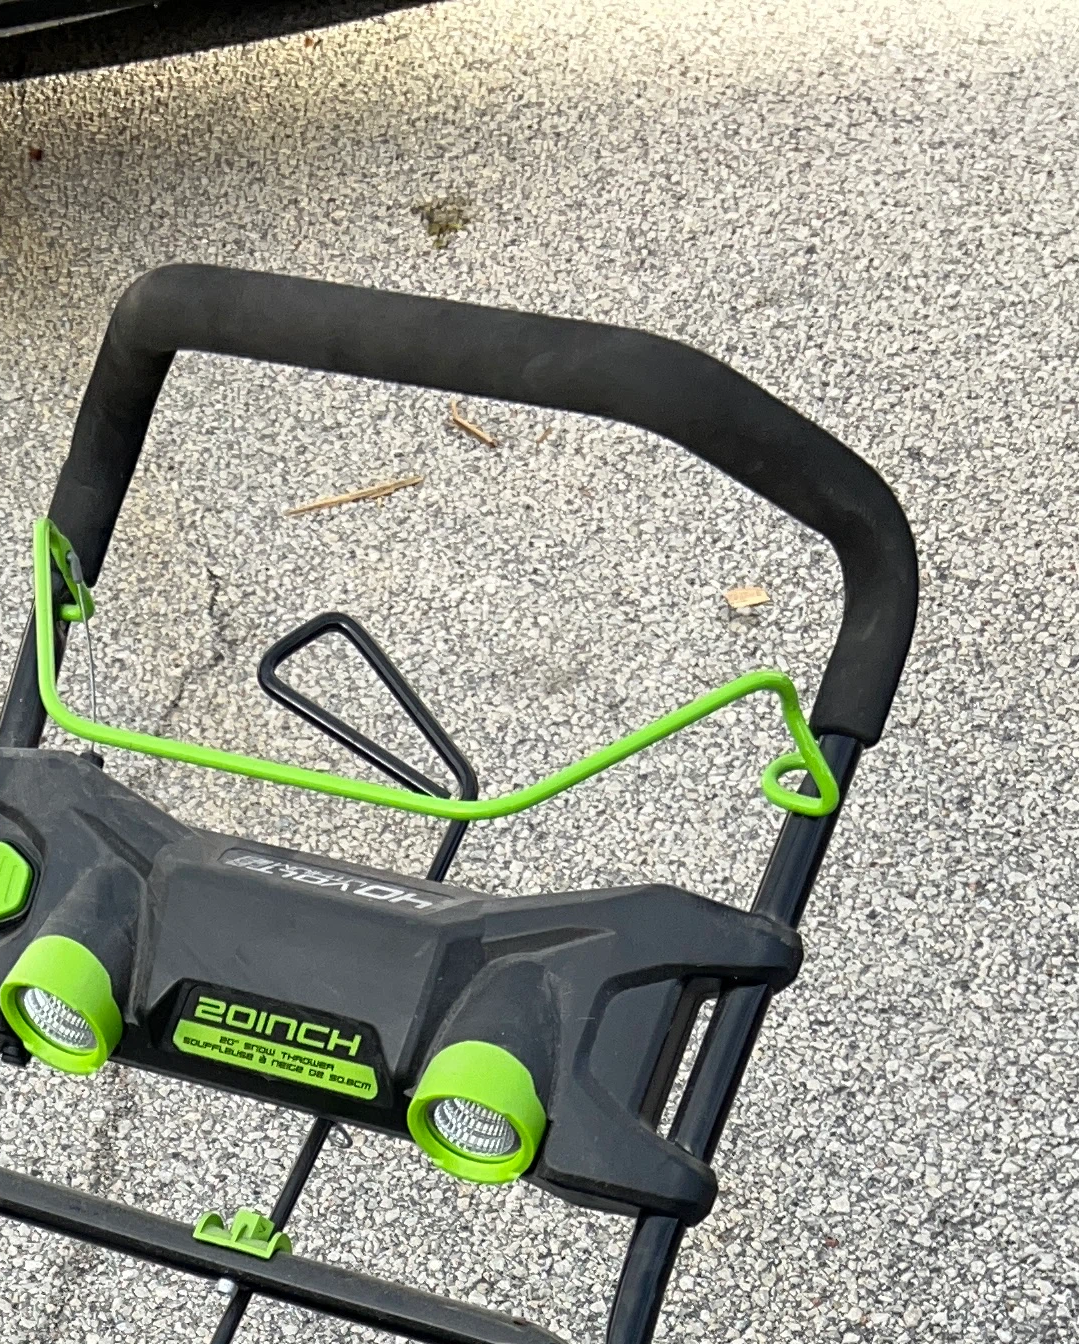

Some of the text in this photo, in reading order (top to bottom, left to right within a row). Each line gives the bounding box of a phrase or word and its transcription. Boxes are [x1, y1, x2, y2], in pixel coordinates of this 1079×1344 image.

[194, 996, 362, 1057] 20INCH
[182, 1036, 254, 1061] SOUFFLEUSE
[271, 1059, 304, 1074] NEIGE
[308, 1069, 325, 1080] DE
[244, 1041, 276, 1056] SNOW
[281, 1051, 335, 1071] THROWER
